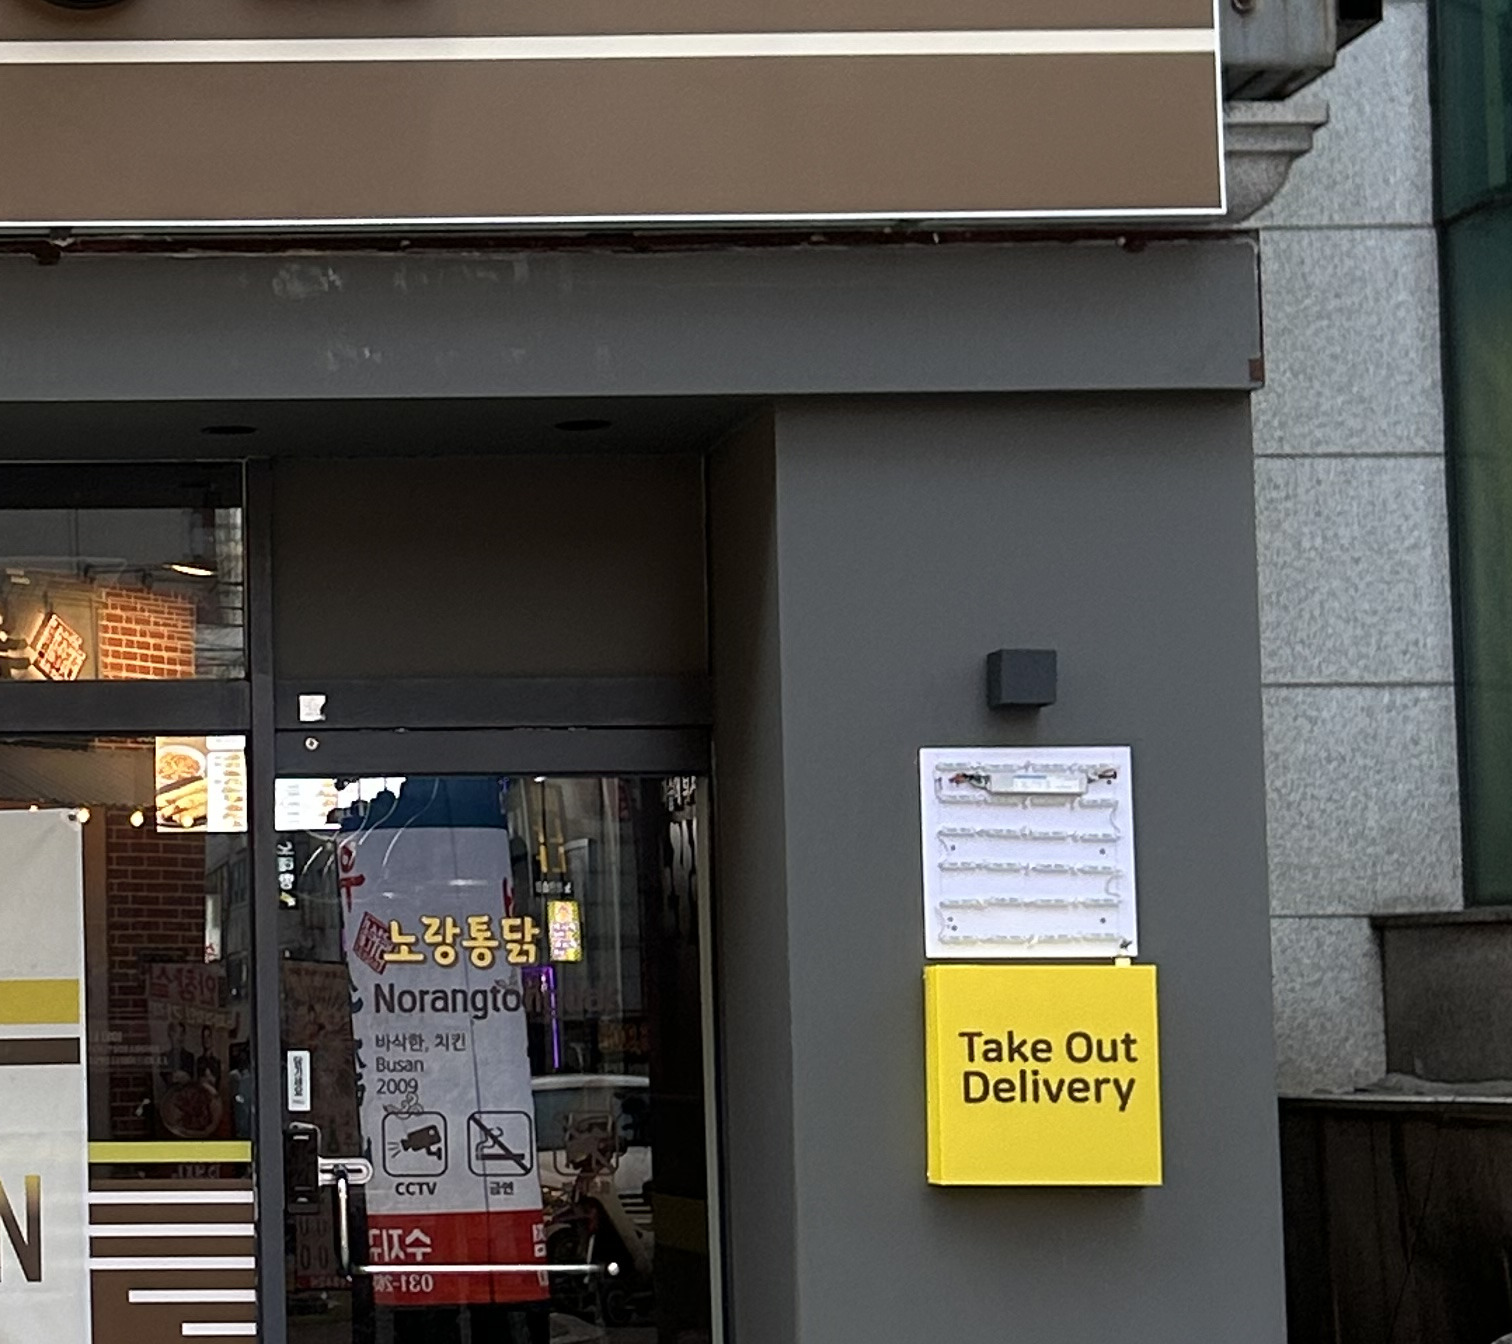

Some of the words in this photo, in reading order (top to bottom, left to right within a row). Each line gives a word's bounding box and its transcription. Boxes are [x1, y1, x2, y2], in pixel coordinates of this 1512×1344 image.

[383, 913, 540, 969] 노랑통닭
[375, 1032, 429, 1053] 바삭한,
[434, 1032, 467, 1052] 치킨
[958, 1030, 1053, 1063] Take
[1065, 1031, 1138, 1063] Out
[376, 1057, 425, 1073] Busan
[376, 1078, 419, 1095] 2009
[963, 1069, 1136, 1112] Delivery
[395, 1181, 437, 1196] CCTV
[489, 1181, 514, 1196] 금연
